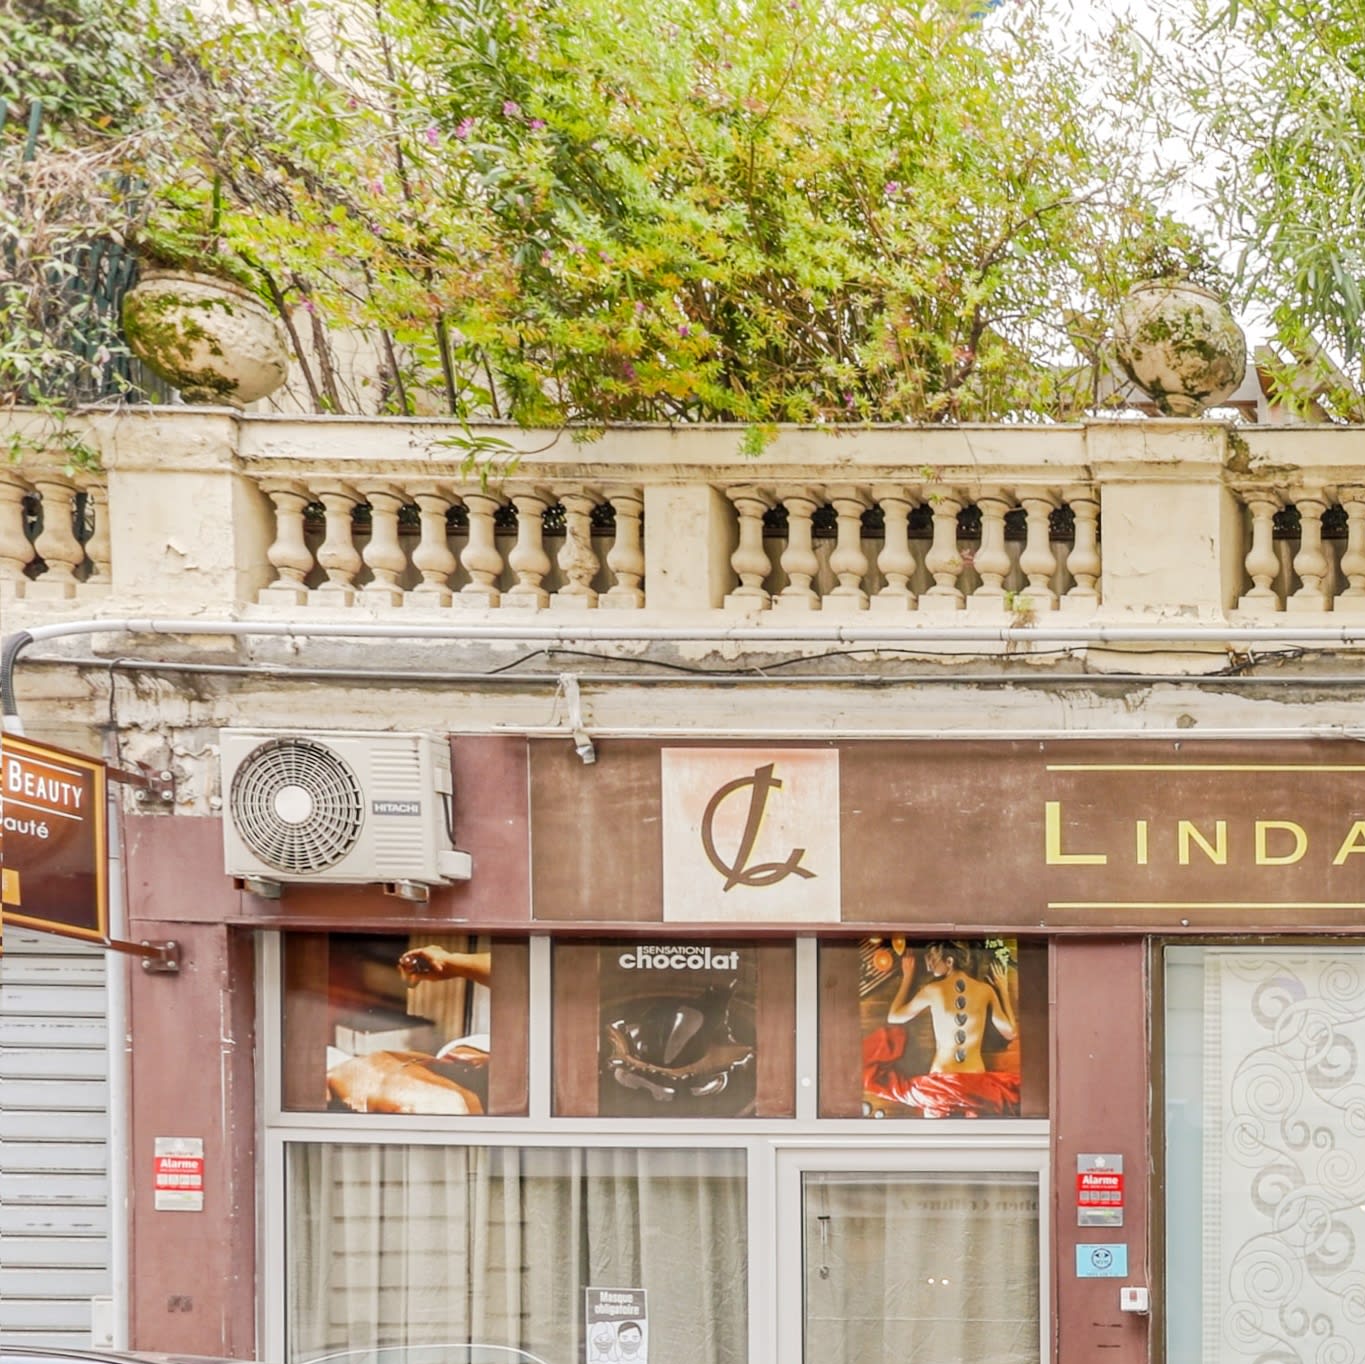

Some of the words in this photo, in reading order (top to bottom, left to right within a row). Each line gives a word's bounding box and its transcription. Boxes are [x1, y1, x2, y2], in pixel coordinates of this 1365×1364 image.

[8, 761, 83, 808] BEAUTY
[374, 803, 419, 813] HITACHI
[3, 816, 49, 839] auté
[642, 946, 705, 955] SENSATION
[618, 946, 740, 970] chocolat
[160, 1158, 199, 1169] Alarme
[1082, 1174, 1119, 1185] Alarme
